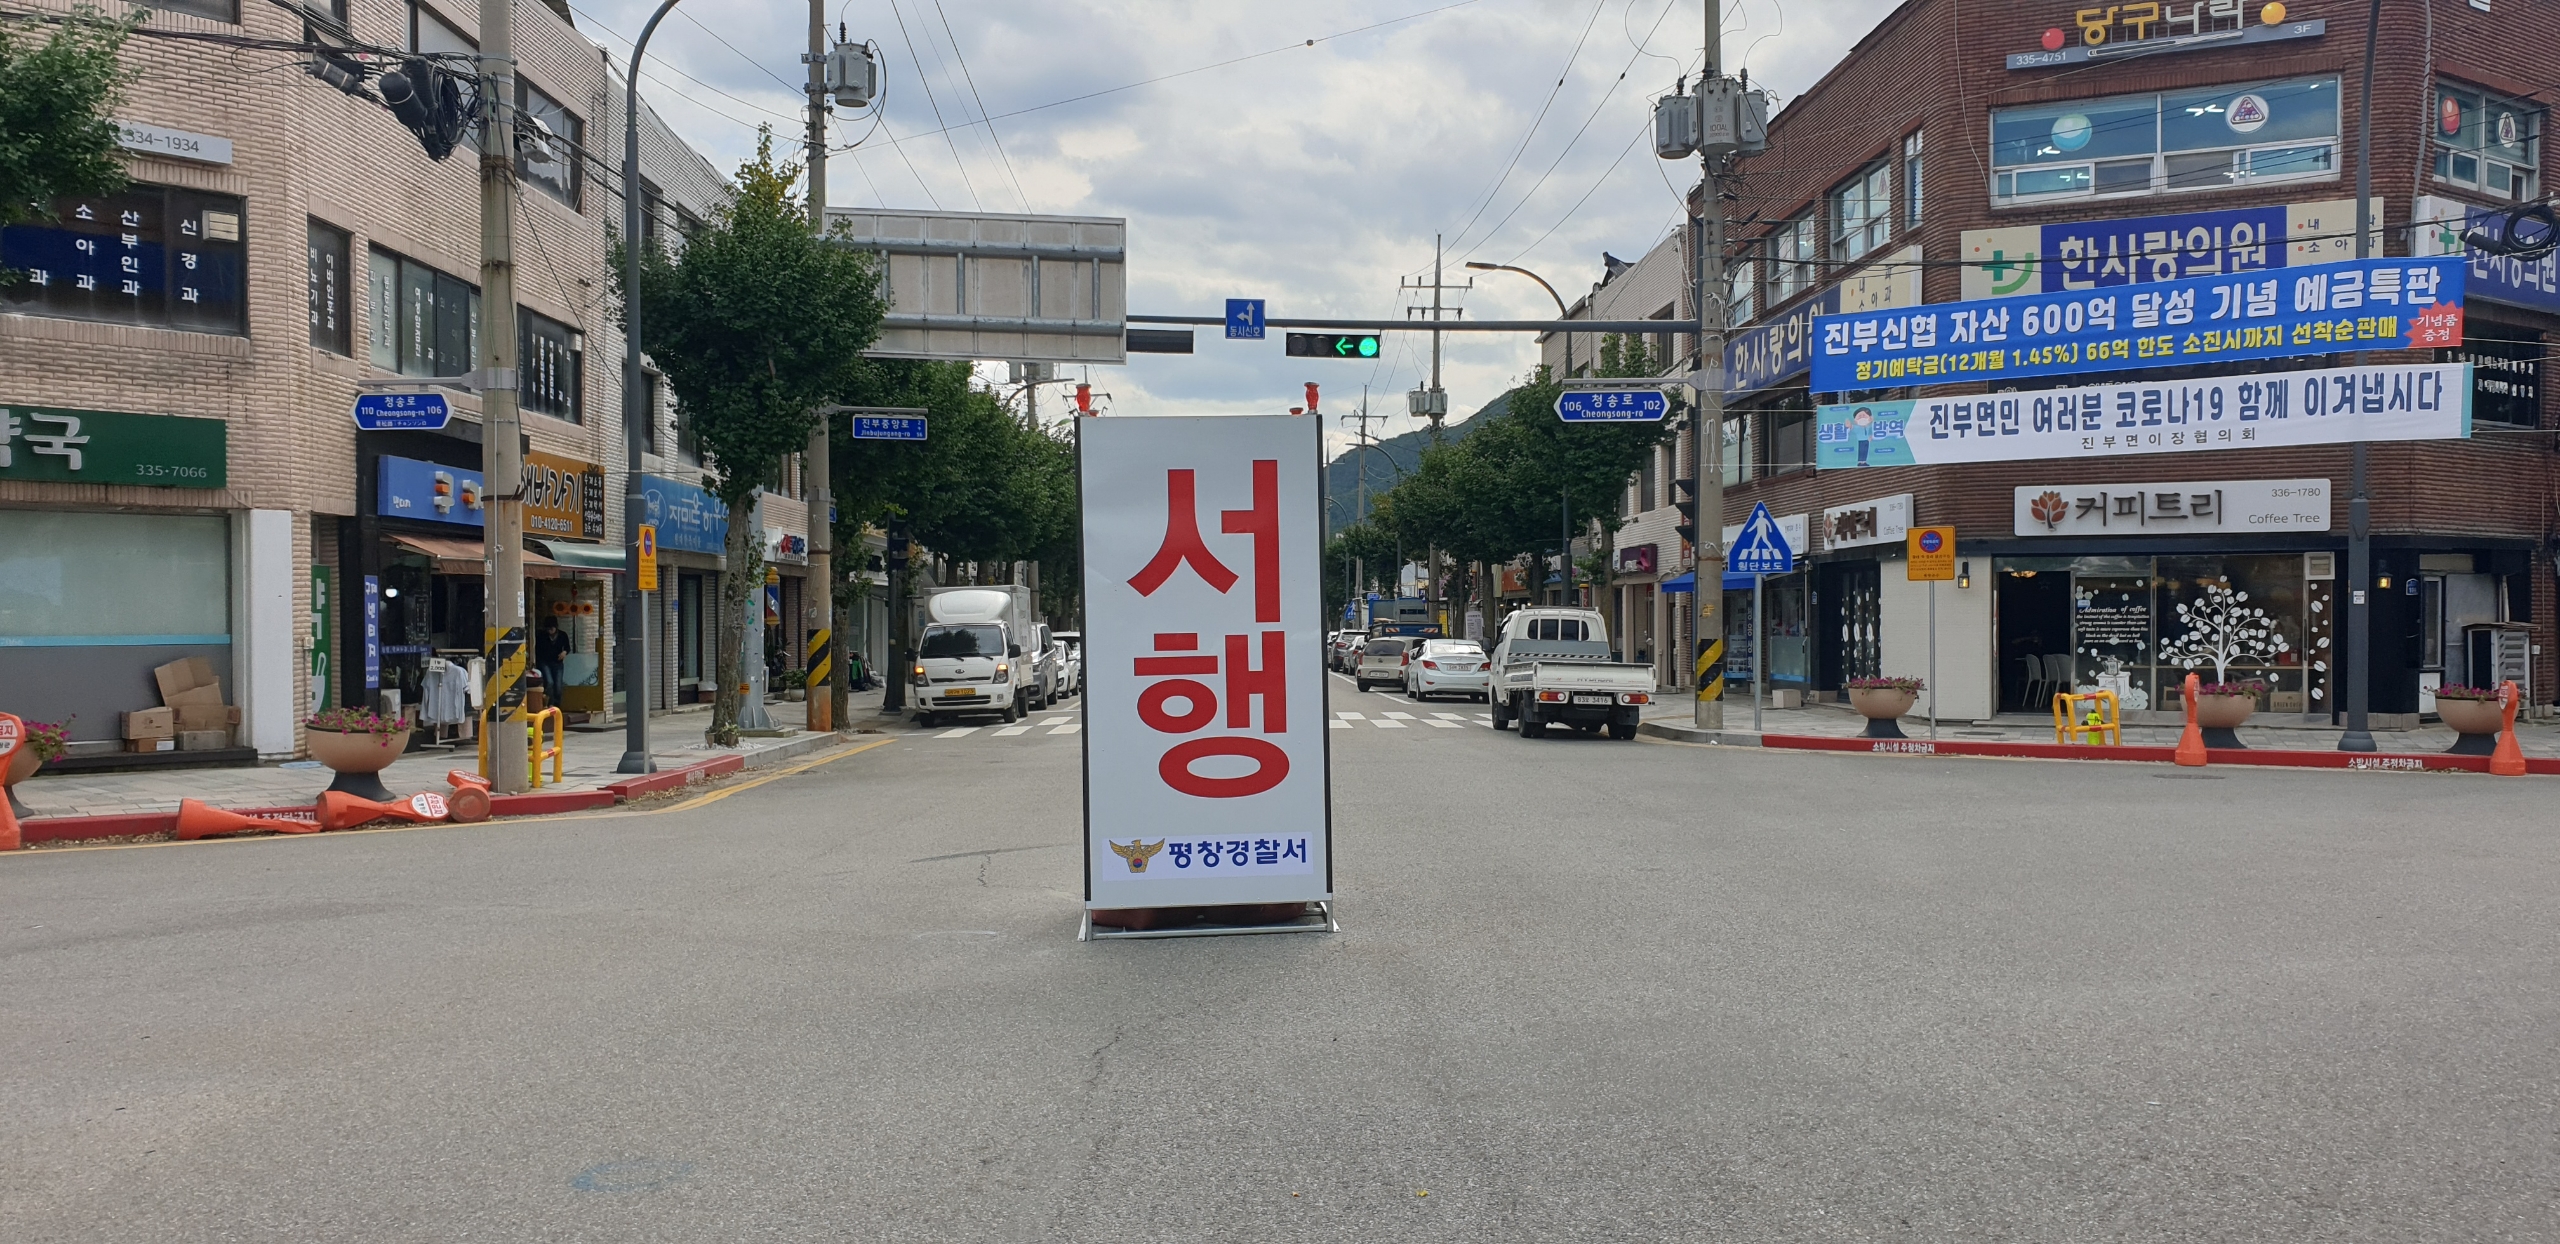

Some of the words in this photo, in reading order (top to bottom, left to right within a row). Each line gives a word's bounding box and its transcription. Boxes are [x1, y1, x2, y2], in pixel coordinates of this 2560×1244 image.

[2077, 0, 2243, 46] 당구나라
[2016, 51, 2067, 66] 335-4751
[2293, 24, 2313, 34] 3F
[75, 204, 95, 291] 소아과
[120, 210, 141, 297] 산부인과
[2059, 219, 2268, 289] 한사랑의원
[180, 219, 199, 303] 신경과
[1824, 313, 1937, 357] 진부신협
[1950, 297, 2010, 344] 자산
[2022, 296, 2117, 339] 600억
[2131, 287, 2195, 329] 달성
[2210, 278, 2279, 321] 기념
[2294, 266, 2441, 313] 예금특판
[2416, 313, 2459, 328] 기념품
[1229, 325, 1261, 337] 동시신호
[2422, 328, 2451, 342] 증정
[1855, 350, 2005, 381] 정기예탁금(12개월
[2012, 342, 2078, 367] 1.45%)
[2086, 336, 2129, 360] 66억
[2137, 334, 2174, 357] 한도
[2183, 325, 2283, 354] 소진시까지
[2291, 315, 2398, 345] 선착순판매
[385, 396, 416, 408] 청송로
[1564, 401, 1582, 411] 106
[1581, 410, 1644, 419] Cheongsong-ro
[1643, 400, 1661, 411] 102
[1592, 393, 1634, 408] 청송로
[1930, 397, 2019, 440] 진부면민
[2033, 391, 2103, 433] 여러분
[2115, 385, 2224, 429] 코로나19
[2238, 379, 2290, 422] 함께
[2304, 370, 2443, 416] 이겨냅시다
[361, 406, 374, 415] 110
[376, 409, 425, 417] Cheongsong-ro
[427, 406, 442, 415] 106
[862, 418, 909, 429] 진부중앙로
[1818, 422, 1849, 442] 생활
[1873, 419, 1905, 439] 방역
[2271, 488, 2321, 498] 336-1780
[2076, 489, 2223, 527] 커피트리
[2248, 513, 2289, 524] Coffee
[2292, 513, 2320, 523] Tree
[531, 514, 573, 532] 010-4120-6511
[1737, 561, 1784, 571] 횡단보도
[1126, 459, 1290, 798] 서행
[1901, 742, 1935, 754] 주정차금지
[1168, 837, 1307, 869] 평창경찰서
